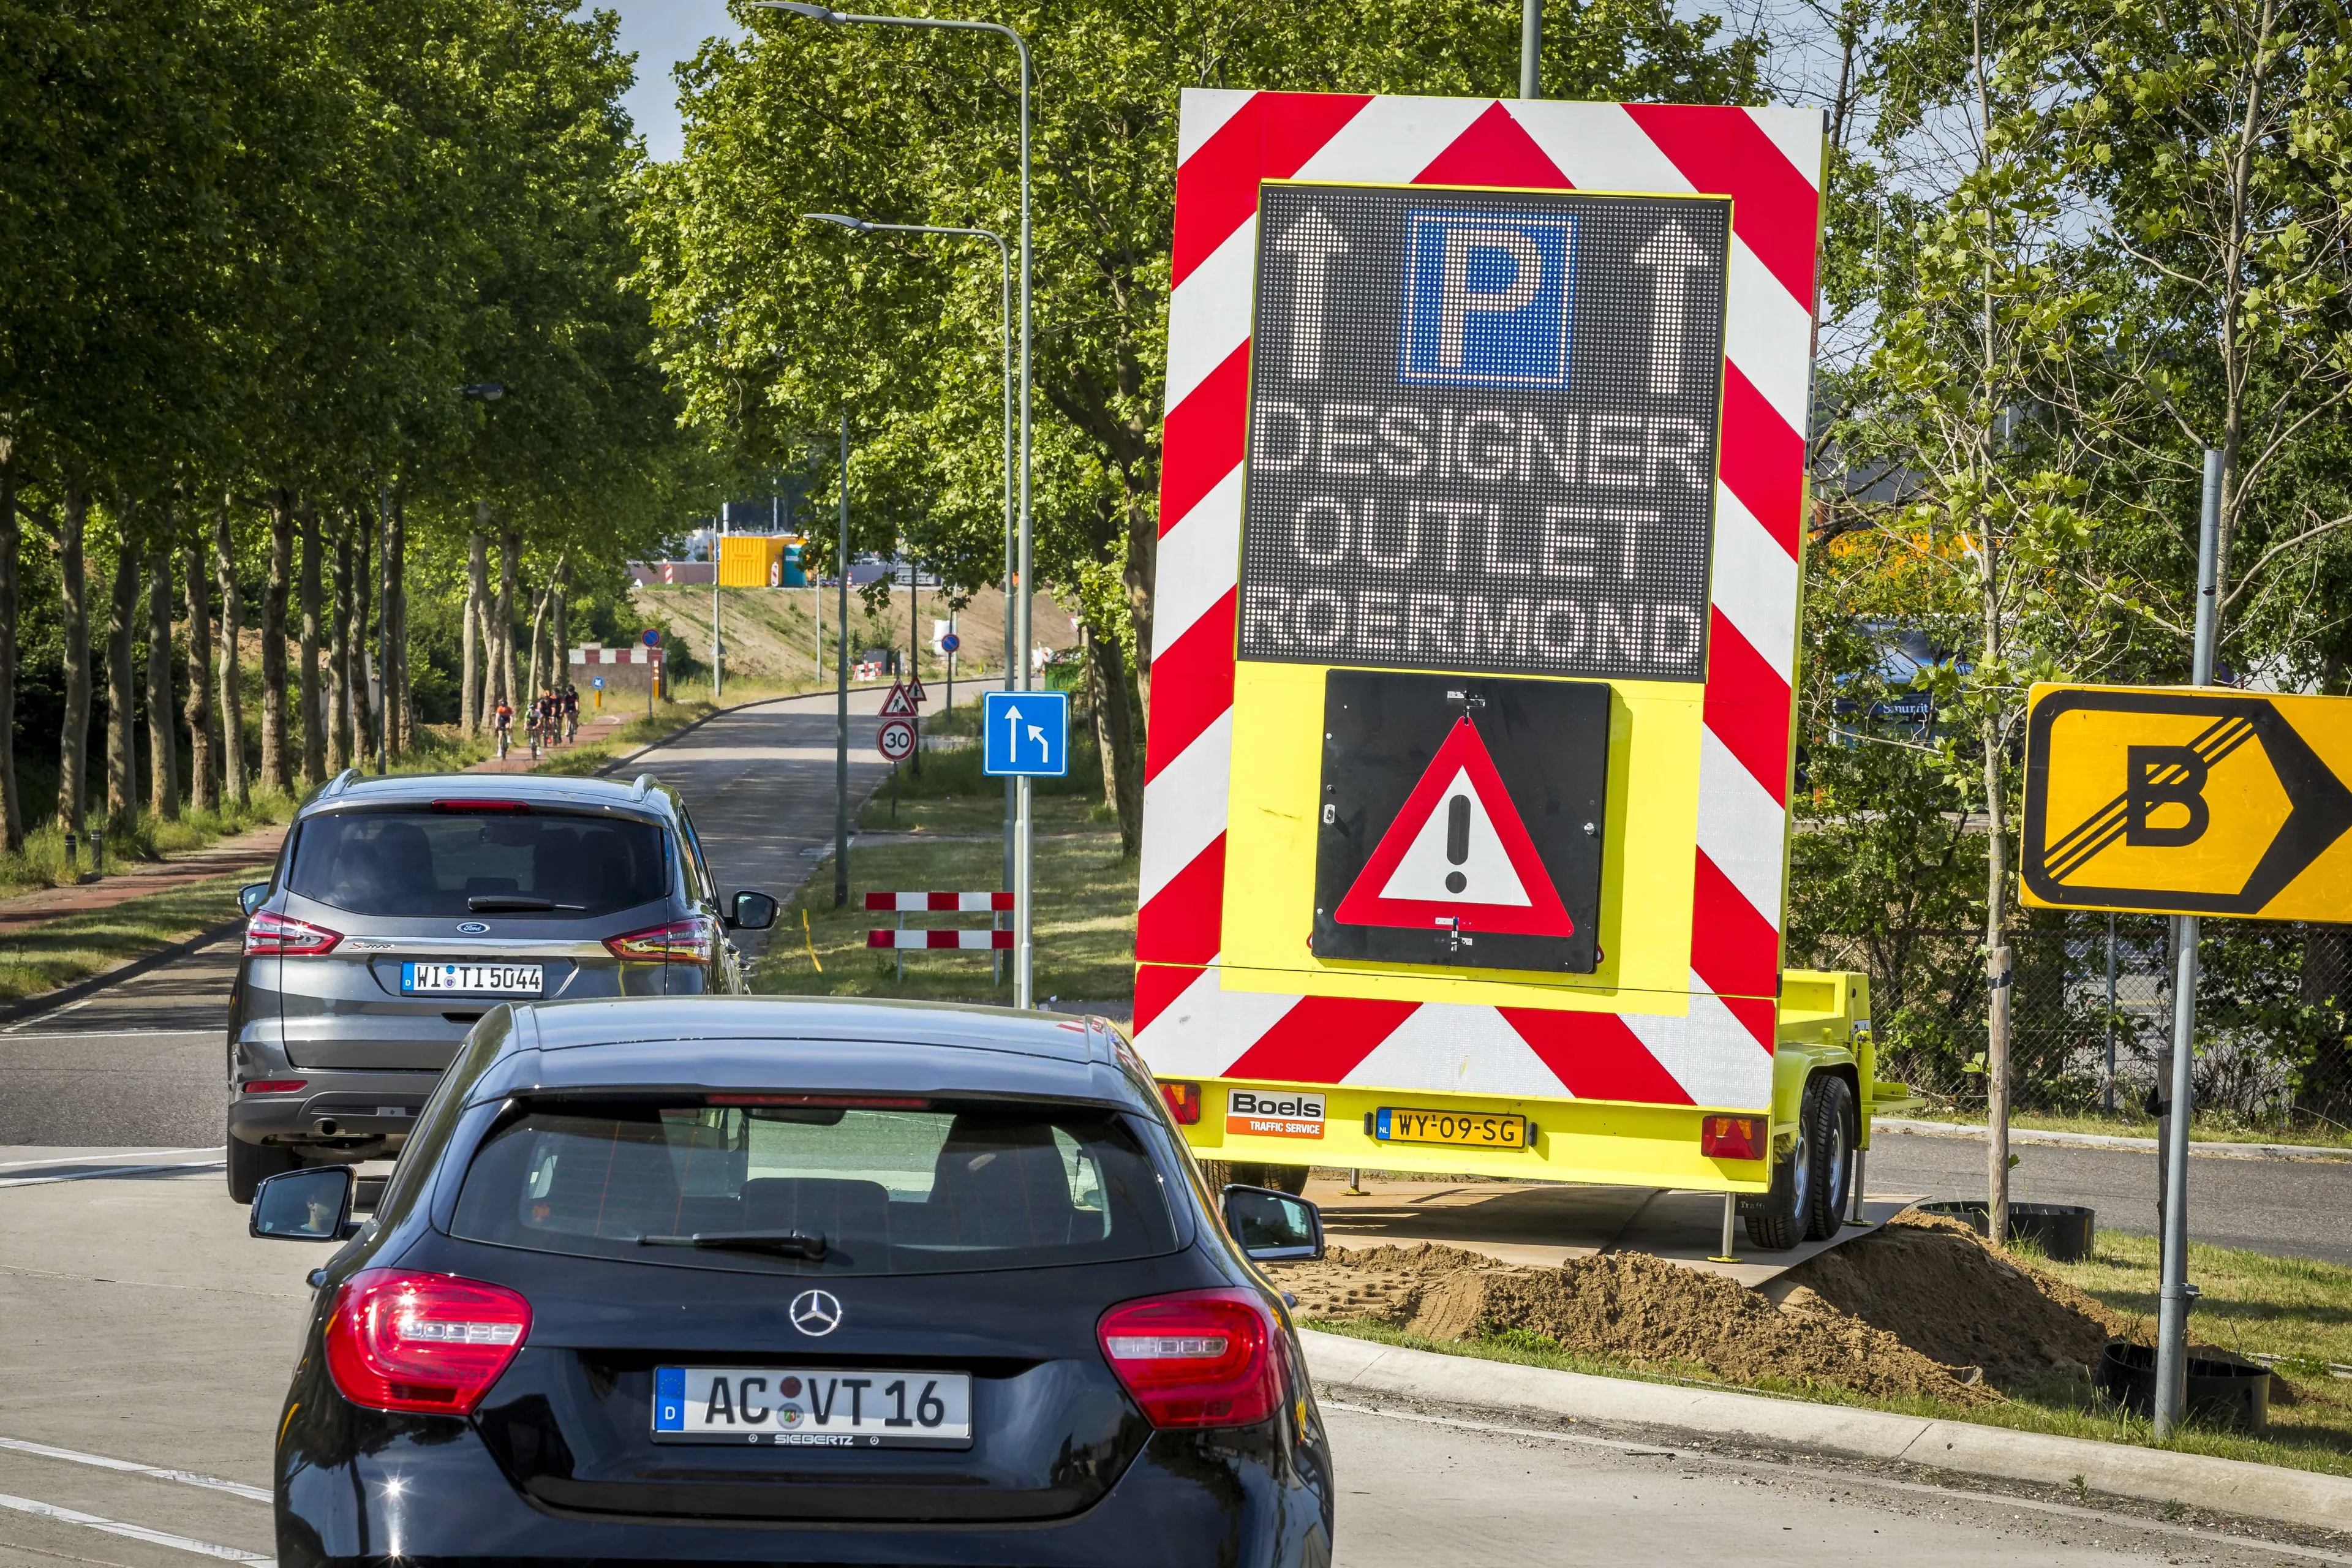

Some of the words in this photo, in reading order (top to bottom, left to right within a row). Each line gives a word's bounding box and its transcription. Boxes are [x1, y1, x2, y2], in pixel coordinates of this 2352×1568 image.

[1439, 229, 1545, 369] P
[1252, 399, 1709, 489] DESIGNER
[1294, 496, 1660, 579] OUTLET
[1243, 585, 1702, 663] ROERMOND
[885, 732, 910, 748] 30
[2126, 745, 2210, 847] B
[417, 967, 440, 987] WI
[490, 967, 540, 989] 5044
[1232, 1093, 1321, 1118] Boels
[1250, 1120, 1284, 1132] TRAFFIC
[1285, 1123, 1320, 1134] SERVICE
[1379, 1125, 1389, 1134] NL
[1398, 1114, 1514, 1142] WY-09-SG
[665, 1406, 676, 1420] D
[704, 1377, 769, 1423] AC
[807, 1378, 872, 1426] VT
[884, 1380, 945, 1428] 16
[774, 1434, 854, 1446] SIEBERTZ
